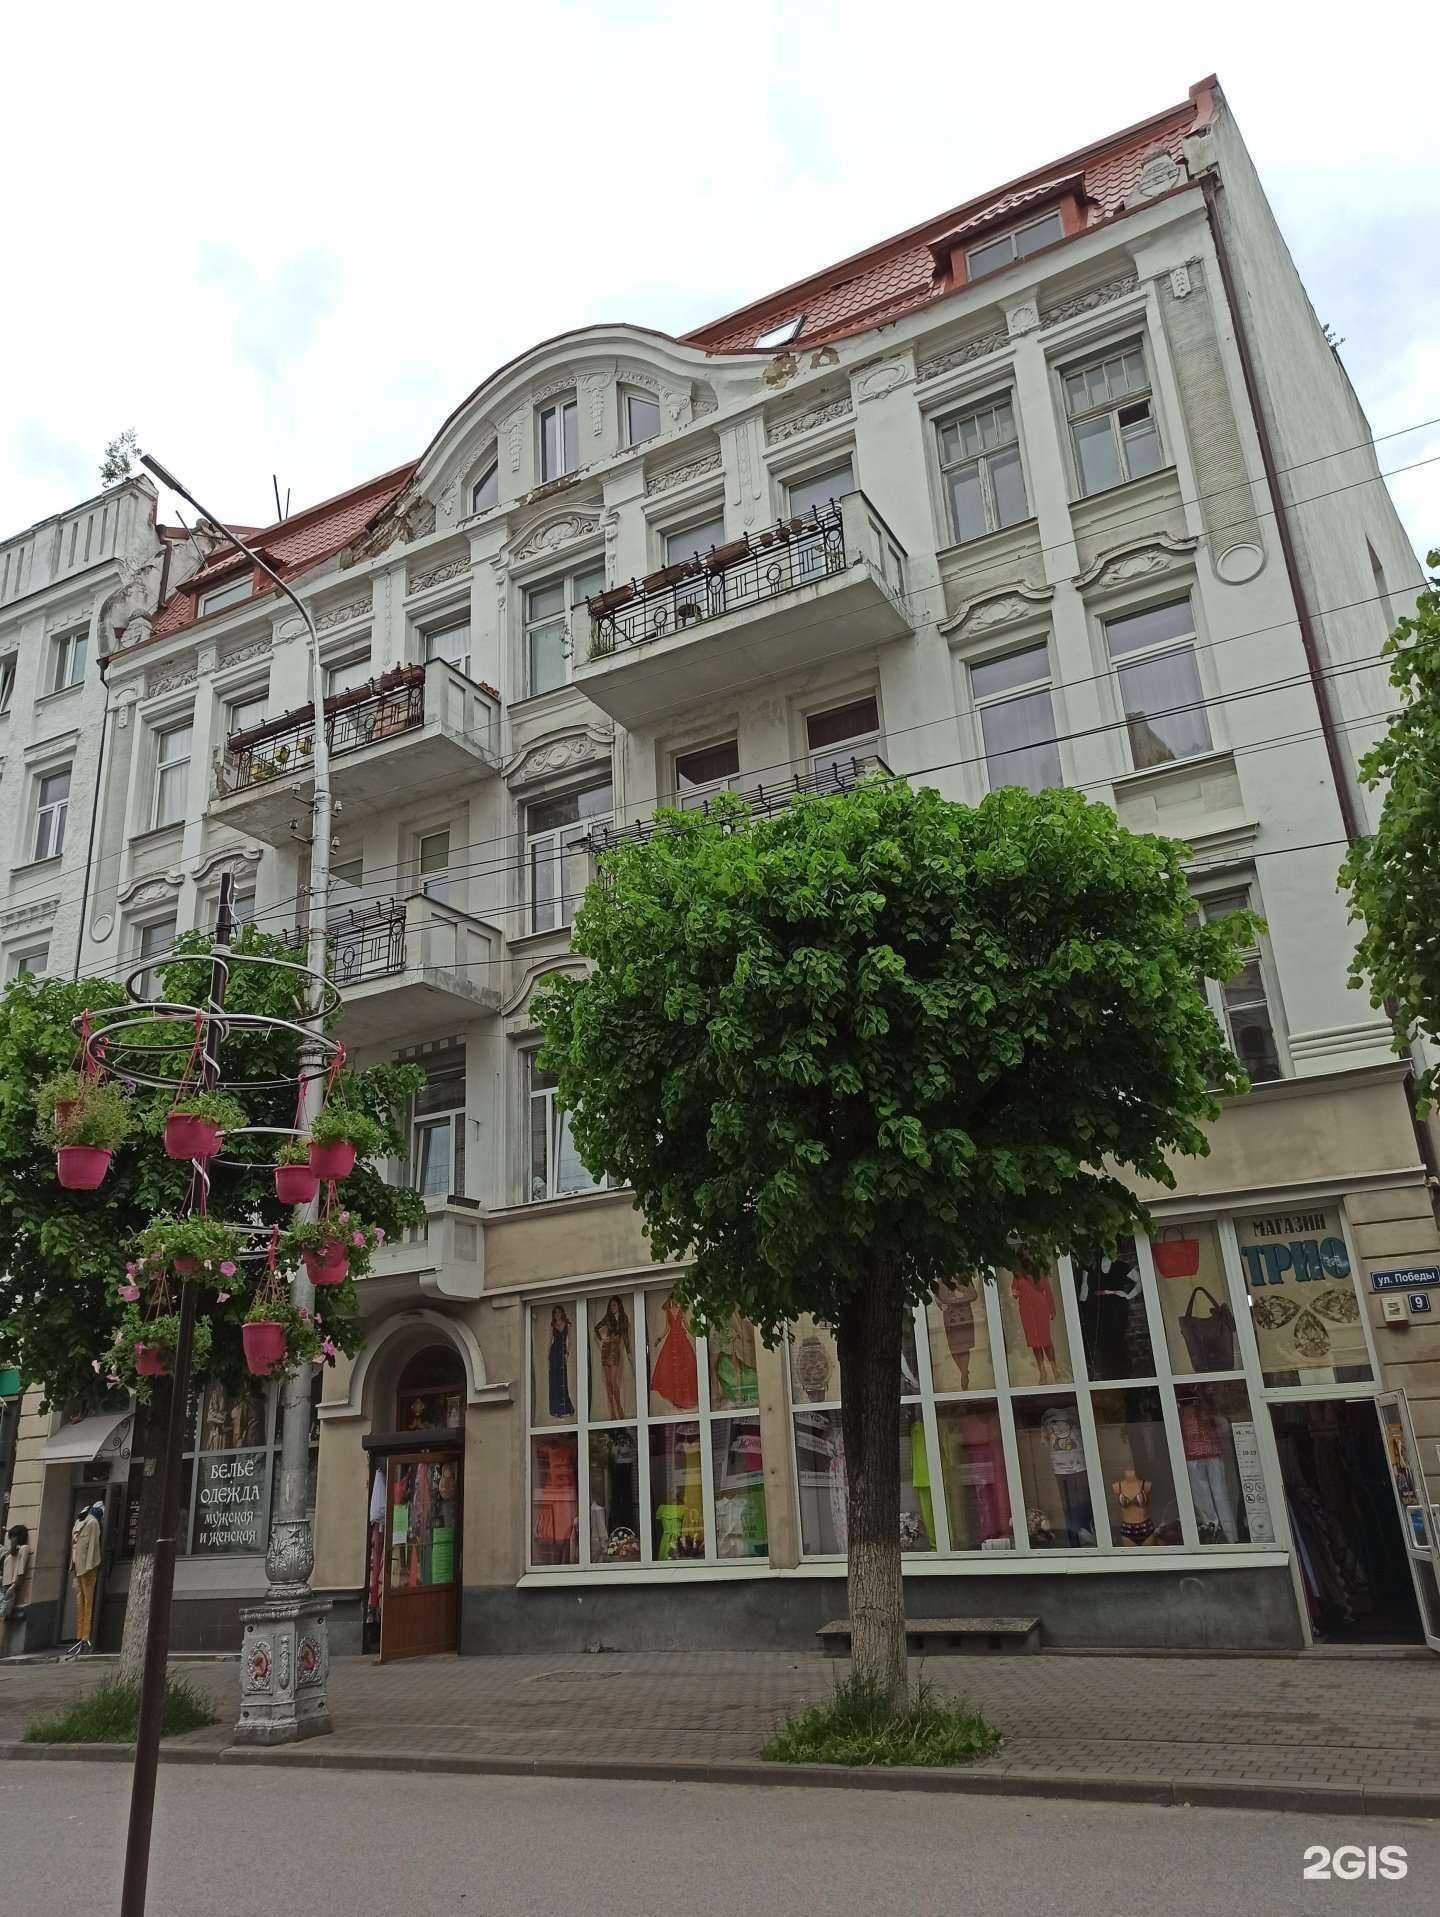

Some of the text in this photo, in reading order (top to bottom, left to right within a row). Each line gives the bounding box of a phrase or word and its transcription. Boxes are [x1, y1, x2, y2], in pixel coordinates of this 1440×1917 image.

[1252, 1213, 1326, 1237] МАГАЗИН
[1241, 1236, 1351, 1287] ТРИО
[1377, 1271, 1435, 1287] ул. Победы
[1414, 1296, 1423, 1308] 9
[200, 1485, 260, 1504] ОДЕЖДА
[199, 1532, 207, 1544] и
